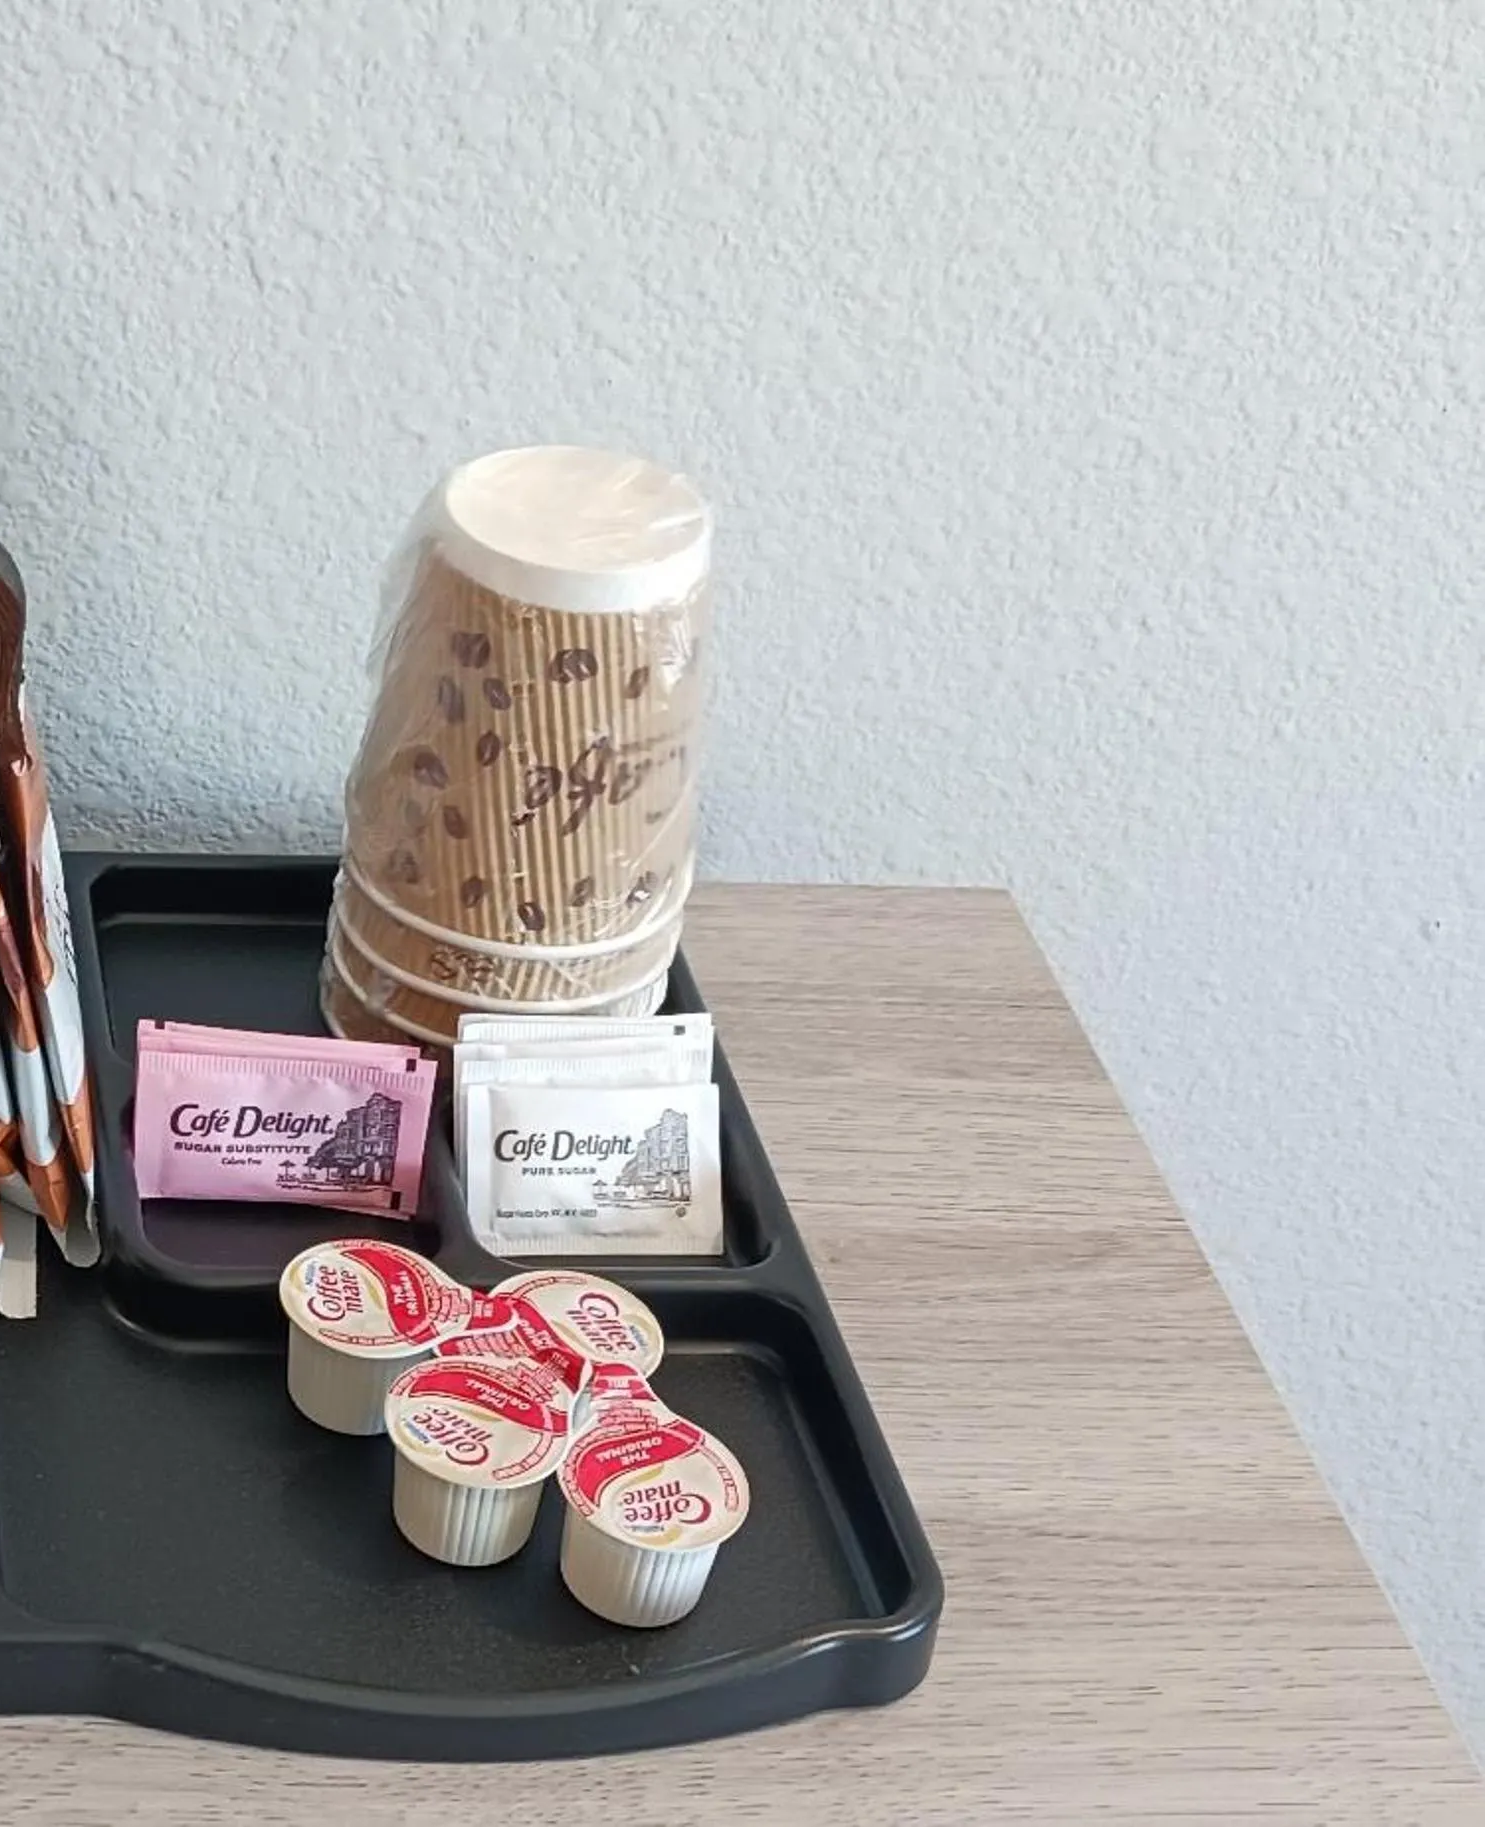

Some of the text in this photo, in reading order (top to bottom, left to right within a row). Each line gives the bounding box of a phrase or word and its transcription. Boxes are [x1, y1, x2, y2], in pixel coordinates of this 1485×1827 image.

[169, 1103, 230, 1137] Café
[173, 1141, 312, 1155] SUGAR SUBSTITUTE
[493, 1129, 547, 1163] Café
[521, 1166, 598, 1177] PURE SUGAR
[306, 1265, 346, 1321] Coffee
[341, 1270, 364, 1313] mate
[412, 1411, 490, 1466] Coffee
[595, 1436, 663, 1463] ORIGINAL
[620, 1449, 650, 1466] THE
[623, 1480, 682, 1505] mate
[624, 1493, 712, 1525] Coffee
